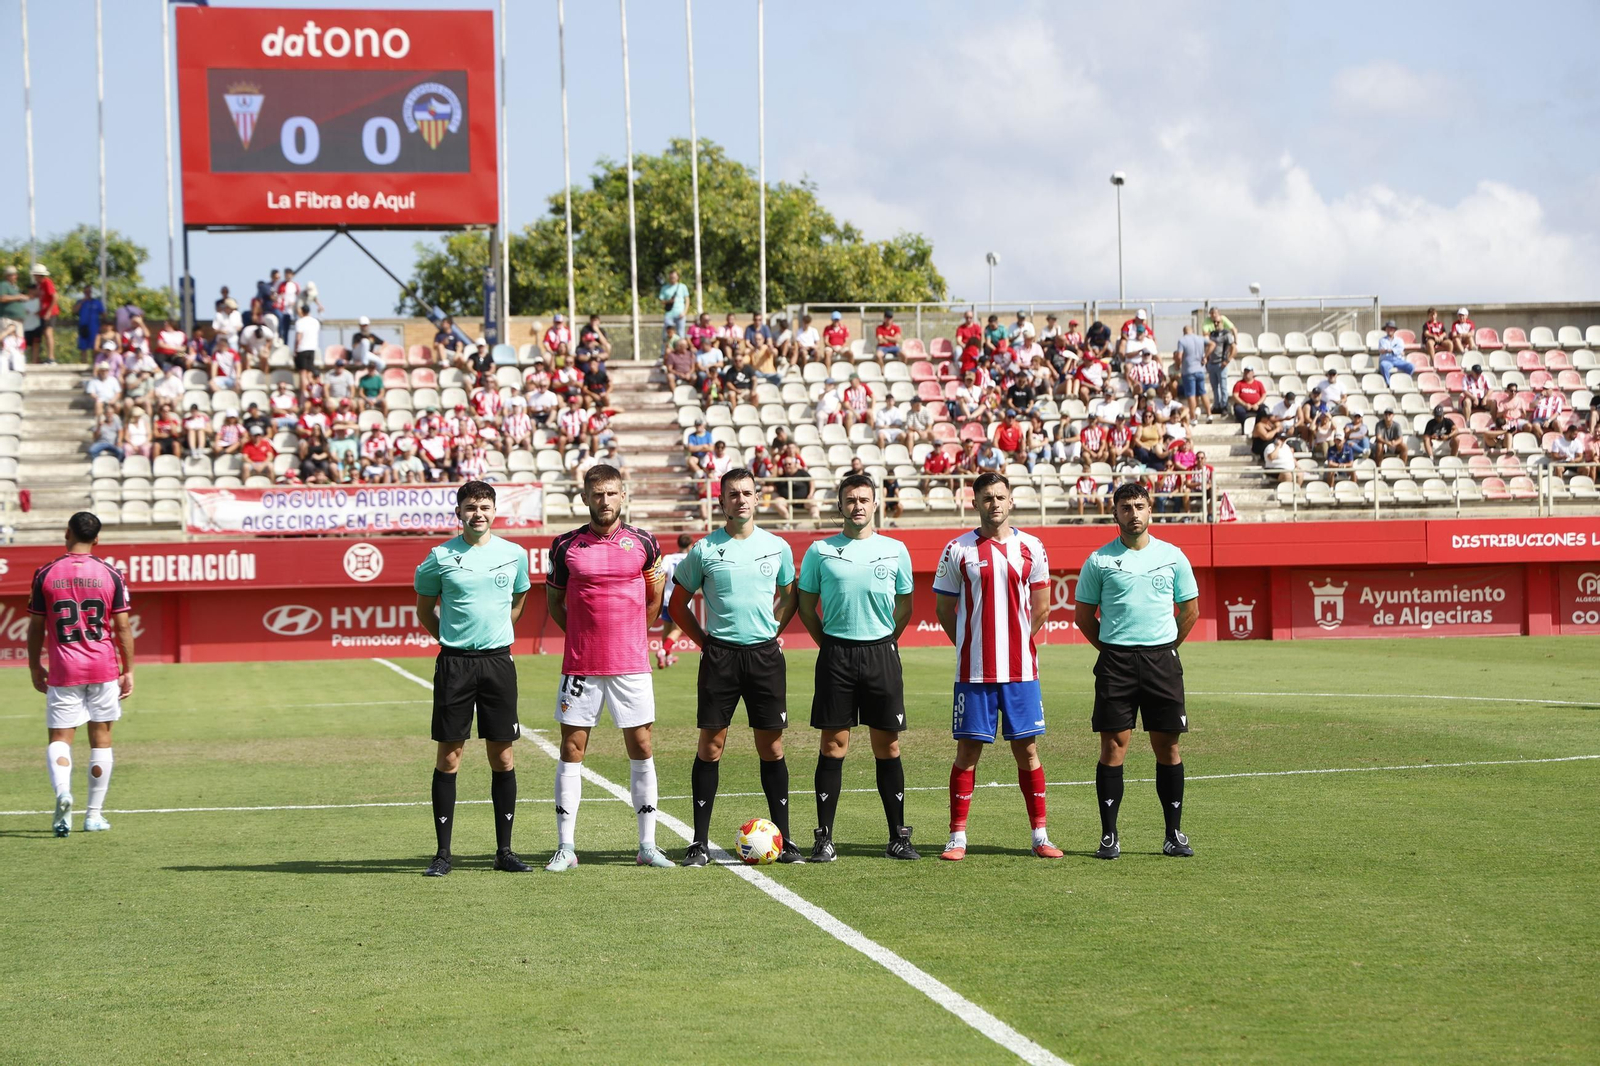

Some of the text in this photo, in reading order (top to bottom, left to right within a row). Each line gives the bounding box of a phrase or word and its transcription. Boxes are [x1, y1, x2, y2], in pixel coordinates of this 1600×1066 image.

[261, 20, 411, 59] datono
[280, 116, 401, 165] 0 0
[267, 191, 416, 213] La Fibra de Aquí
[262, 489, 458, 508] ORGULLO ALBIRROJO
[242, 512, 456, 530] ALGECIRAS EN EL CORAZ
[1452, 532, 1587, 548] DISTRIBUCIONES
[129, 549, 256, 583] FEDERACIÓN
[52, 577, 103, 589] JOEL PRIEGO
[1359, 584, 1506, 609] Ayuntamiento
[52, 599, 106, 644] 23
[331, 605, 420, 629] HYUN
[1373, 605, 1493, 629] de Algeciras
[332, 632, 438, 648] Permotor Alge
[561, 675, 586, 697] 15
[957, 692, 965, 714] 8
